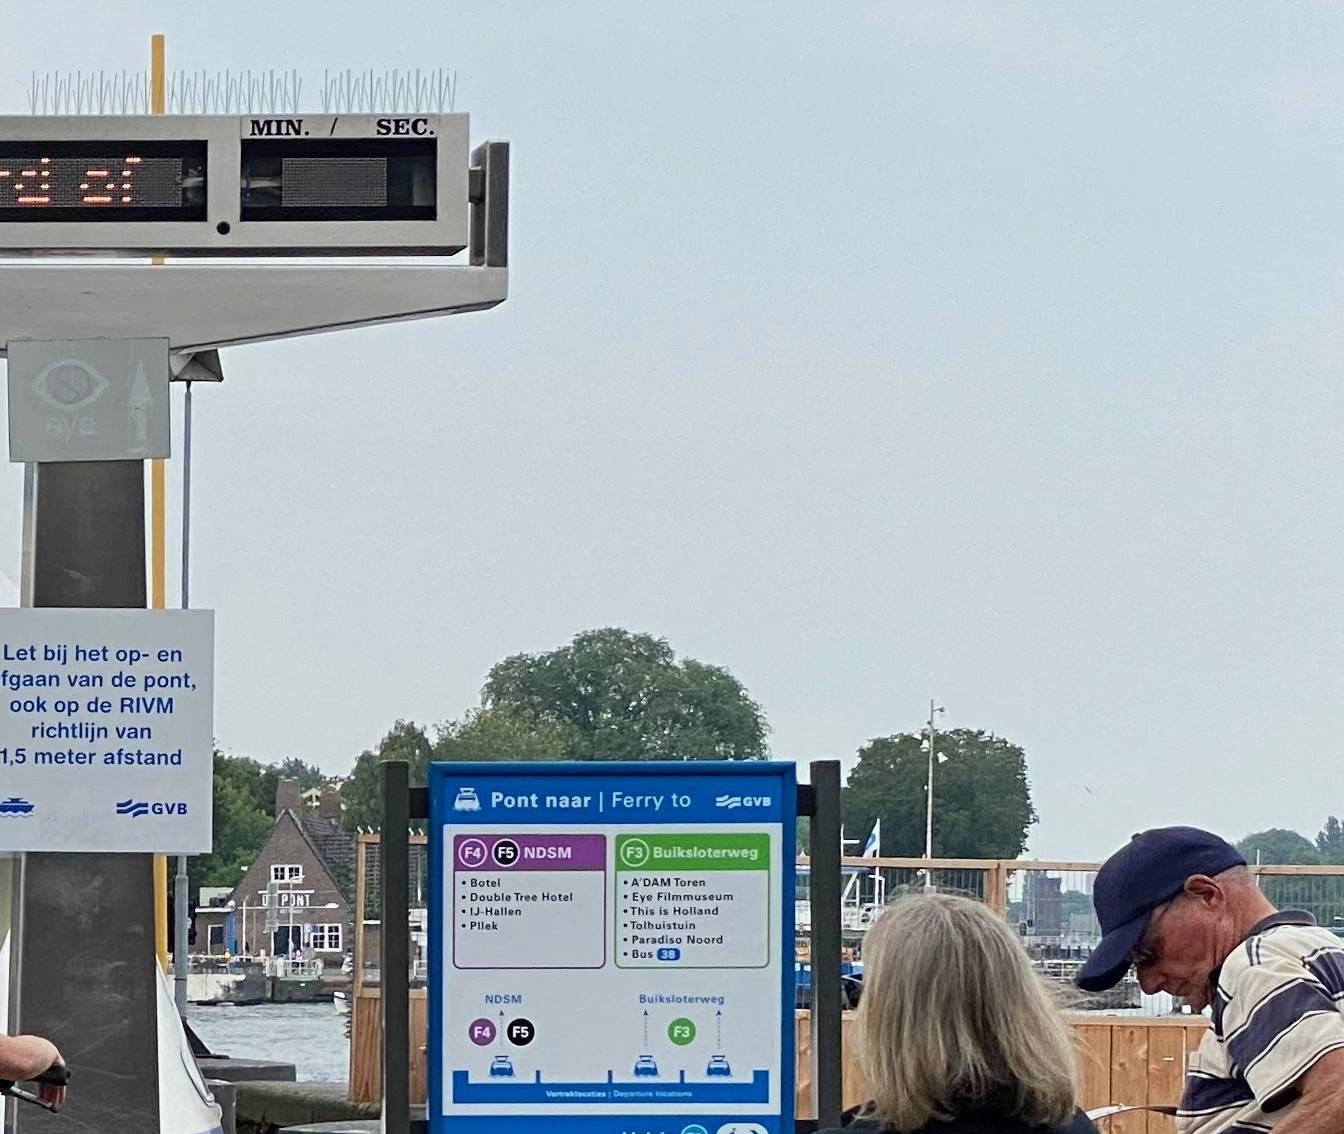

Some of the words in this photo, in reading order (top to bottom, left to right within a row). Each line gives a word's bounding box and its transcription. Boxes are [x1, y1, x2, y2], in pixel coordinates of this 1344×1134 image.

[250, 119, 310, 136] MIN.
[376, 118, 434, 136] SEC.
[46, 415, 97, 443] eye
[3, 644, 36, 662] Let
[43, 644, 68, 665] bij
[75, 645, 108, 662] het
[115, 648, 150, 667] op-
[157, 648, 182, 662] en
[67, 674, 103, 688] van
[111, 671, 136, 688] de
[143, 672, 197, 692] pont,
[10, 697, 47, 714] ook
[54, 700, 79, 719] op
[87, 697, 112, 714] de
[120, 697, 174, 714] RIVM
[31, 722, 108, 743] richtlijn
[115, 726, 152, 740] van
[0, 748, 26, 767] 1,5
[34, 750, 96, 766] meter
[103, 749, 182, 766] afstand
[491, 791, 538, 808] Pont
[545, 795, 591, 808] naar
[612, 791, 664, 811] Ferry
[671, 792, 691, 808] to
[743, 796, 772, 807] GVB
[151, 802, 187, 815] GVB
[464, 847, 481, 859] F4
[497, 846, 515, 859] F5
[524, 846, 572, 859] NDSM
[626, 846, 643, 859] F3
[653, 846, 758, 861] Buiksloterweg
[470, 878, 501, 888] Botel
[673, 878, 706, 887] Toren
[470, 892, 511, 902] Double
[514, 892, 538, 902] Tree
[542, 892, 573, 902] Hotel
[632, 892, 653, 903] Eye
[657, 892, 734, 901] Filmmuseum
[470, 907, 522, 916] IJ-Hallen
[630, 906, 655, 916] This
[659, 906, 668, 916] is
[673, 906, 719, 916] Holland
[630, 920, 696, 930] Tolhuistuin
[632, 935, 682, 944] Paradiso
[686, 935, 724, 944] Noord
[632, 950, 653, 959] Bus
[485, 994, 522, 1005] NDSM
[639, 994, 725, 1006] Buiksloterweg
[474, 1026, 491, 1039] F4
[512, 1026, 529, 1039] F5
[673, 1026, 690, 1038] F3
